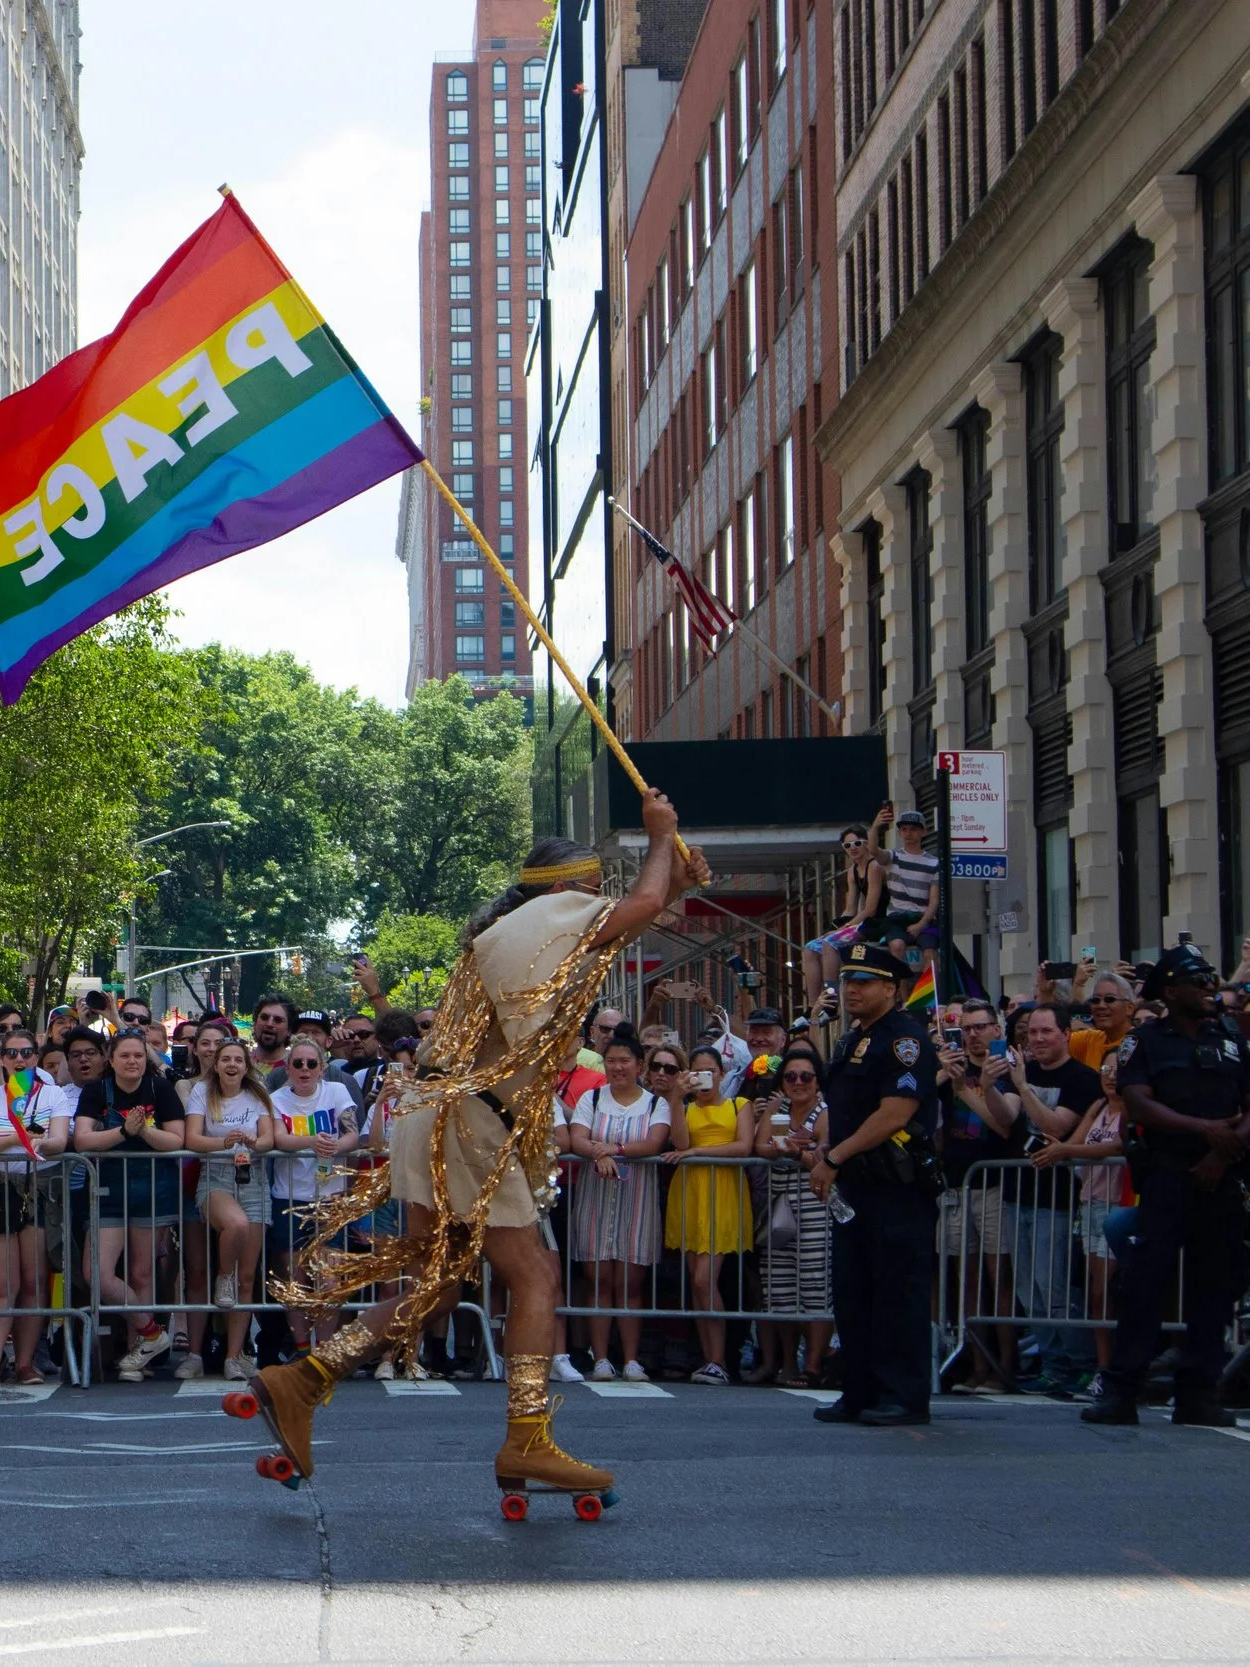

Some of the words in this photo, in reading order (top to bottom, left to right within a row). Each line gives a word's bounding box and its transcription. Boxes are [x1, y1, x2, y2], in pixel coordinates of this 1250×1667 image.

[944, 754, 955, 773] 3
[950, 782, 992, 791] OMMERCIAL
[950, 792, 978, 801] EHICLES
[980, 793, 999, 801] ONLY
[950, 824, 963, 832] cept
[964, 824, 986, 833] Sunday
